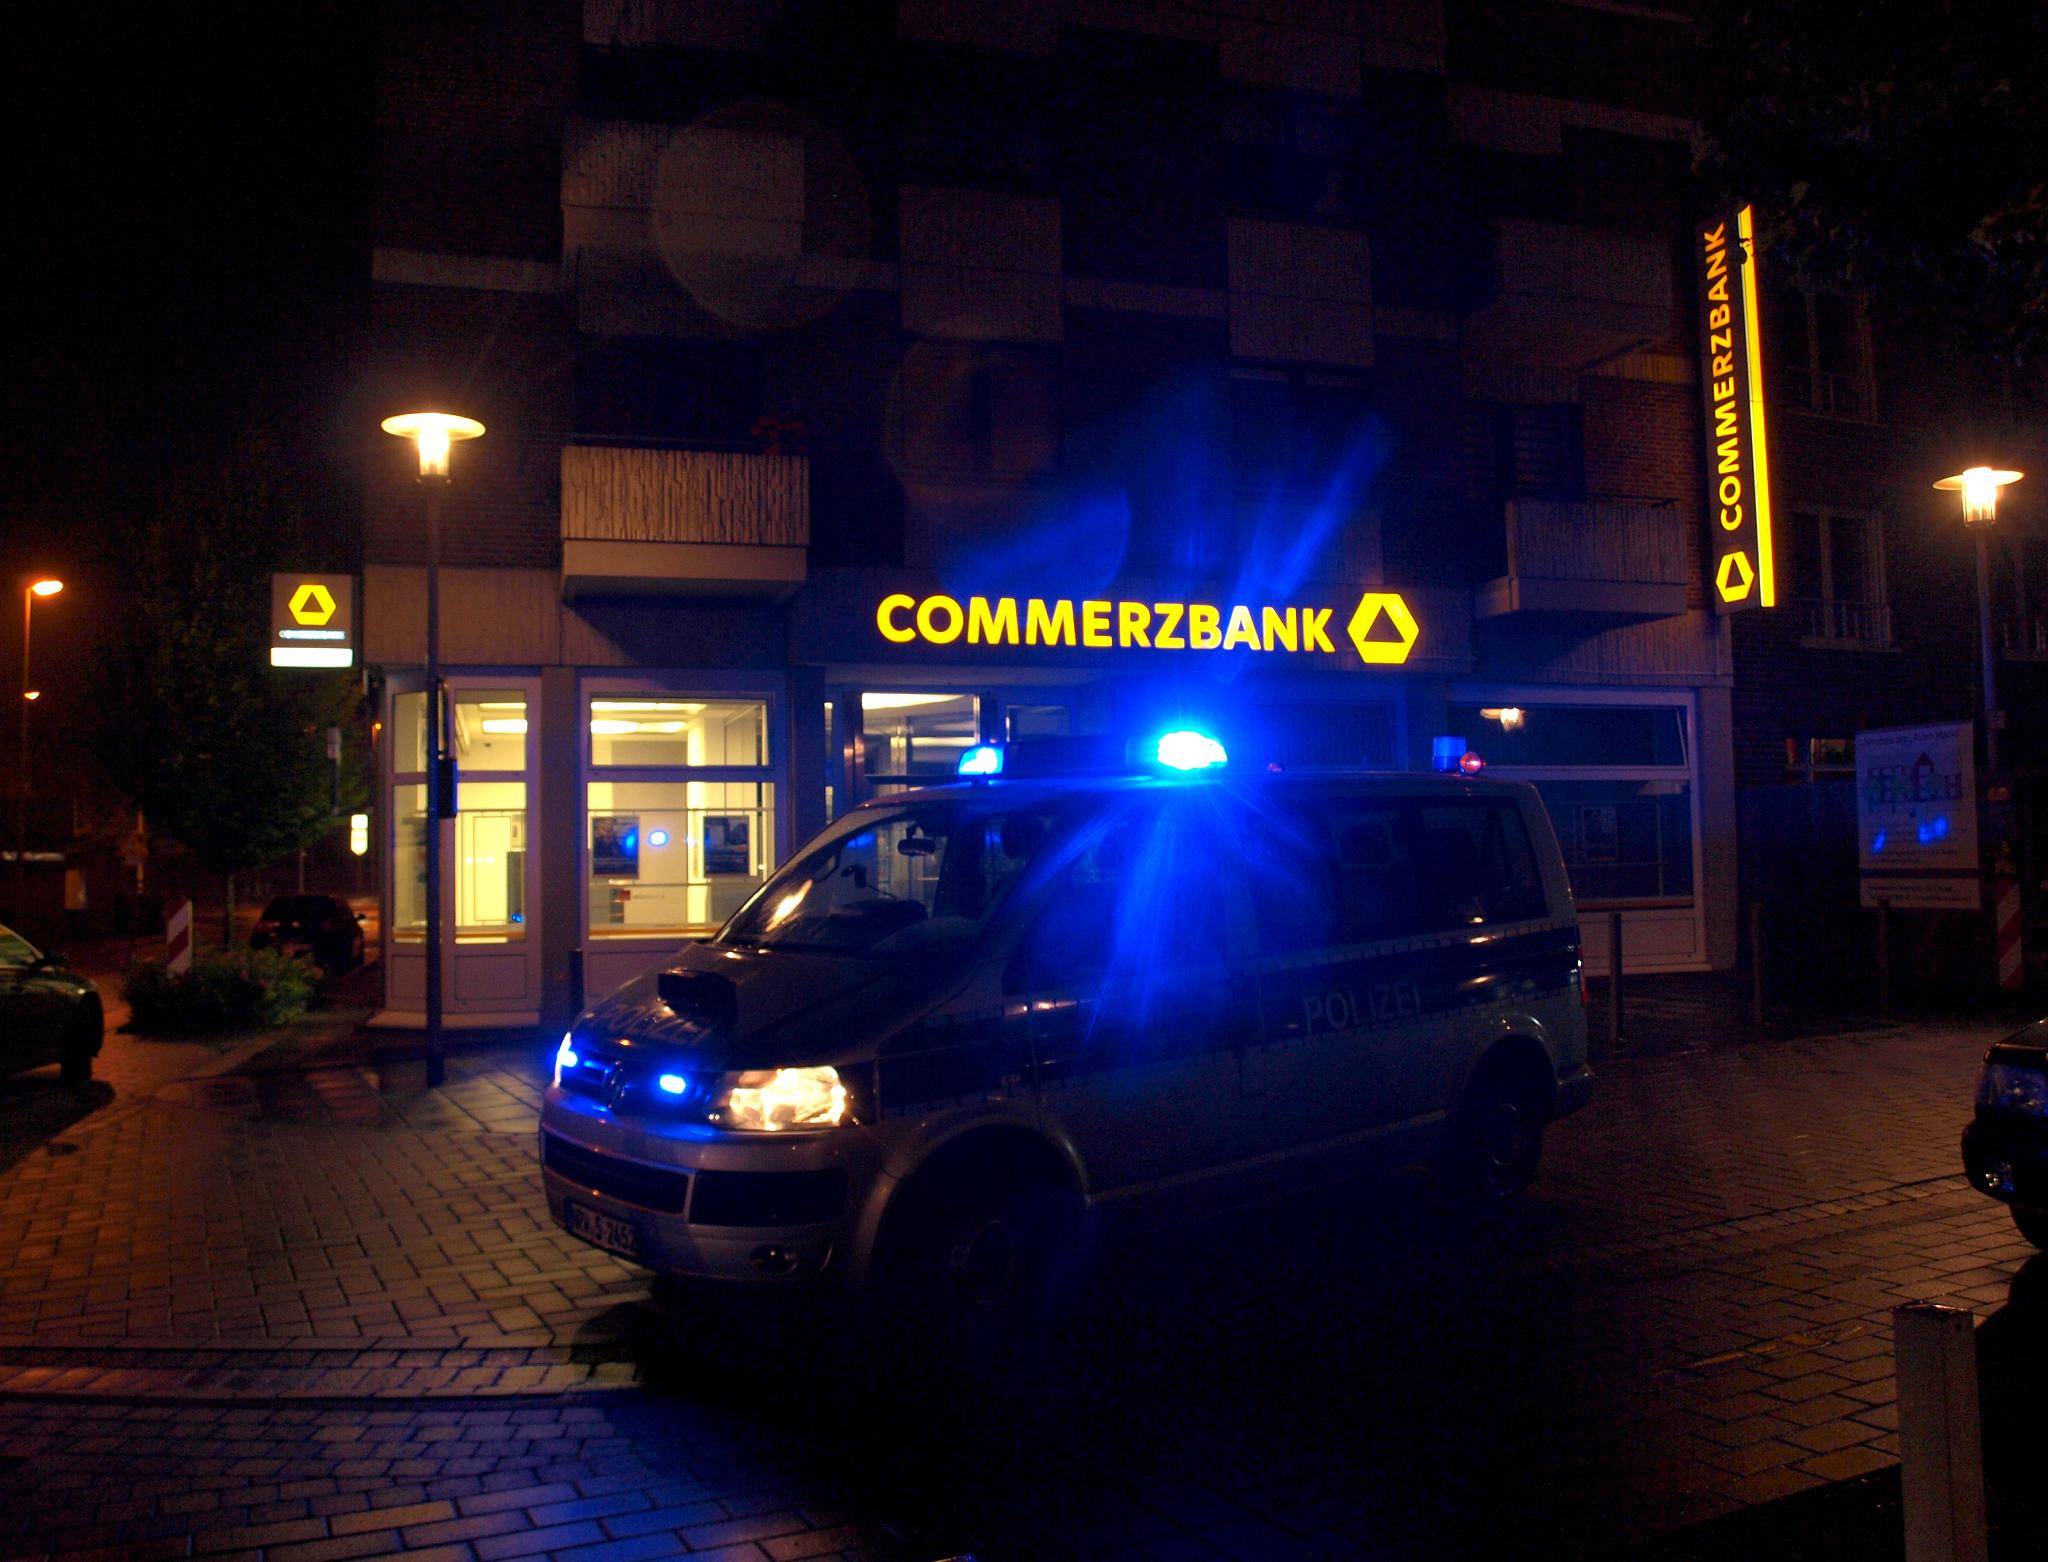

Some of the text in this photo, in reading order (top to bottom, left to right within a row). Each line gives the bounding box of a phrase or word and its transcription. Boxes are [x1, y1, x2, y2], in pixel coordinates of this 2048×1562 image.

[1704, 222, 1743, 531] COMMERZBANK
[876, 593, 1336, 653] COMMERZBANK
[589, 1004, 714, 1048] POLIZEI
[1302, 983, 1421, 1032] POLIZEI
